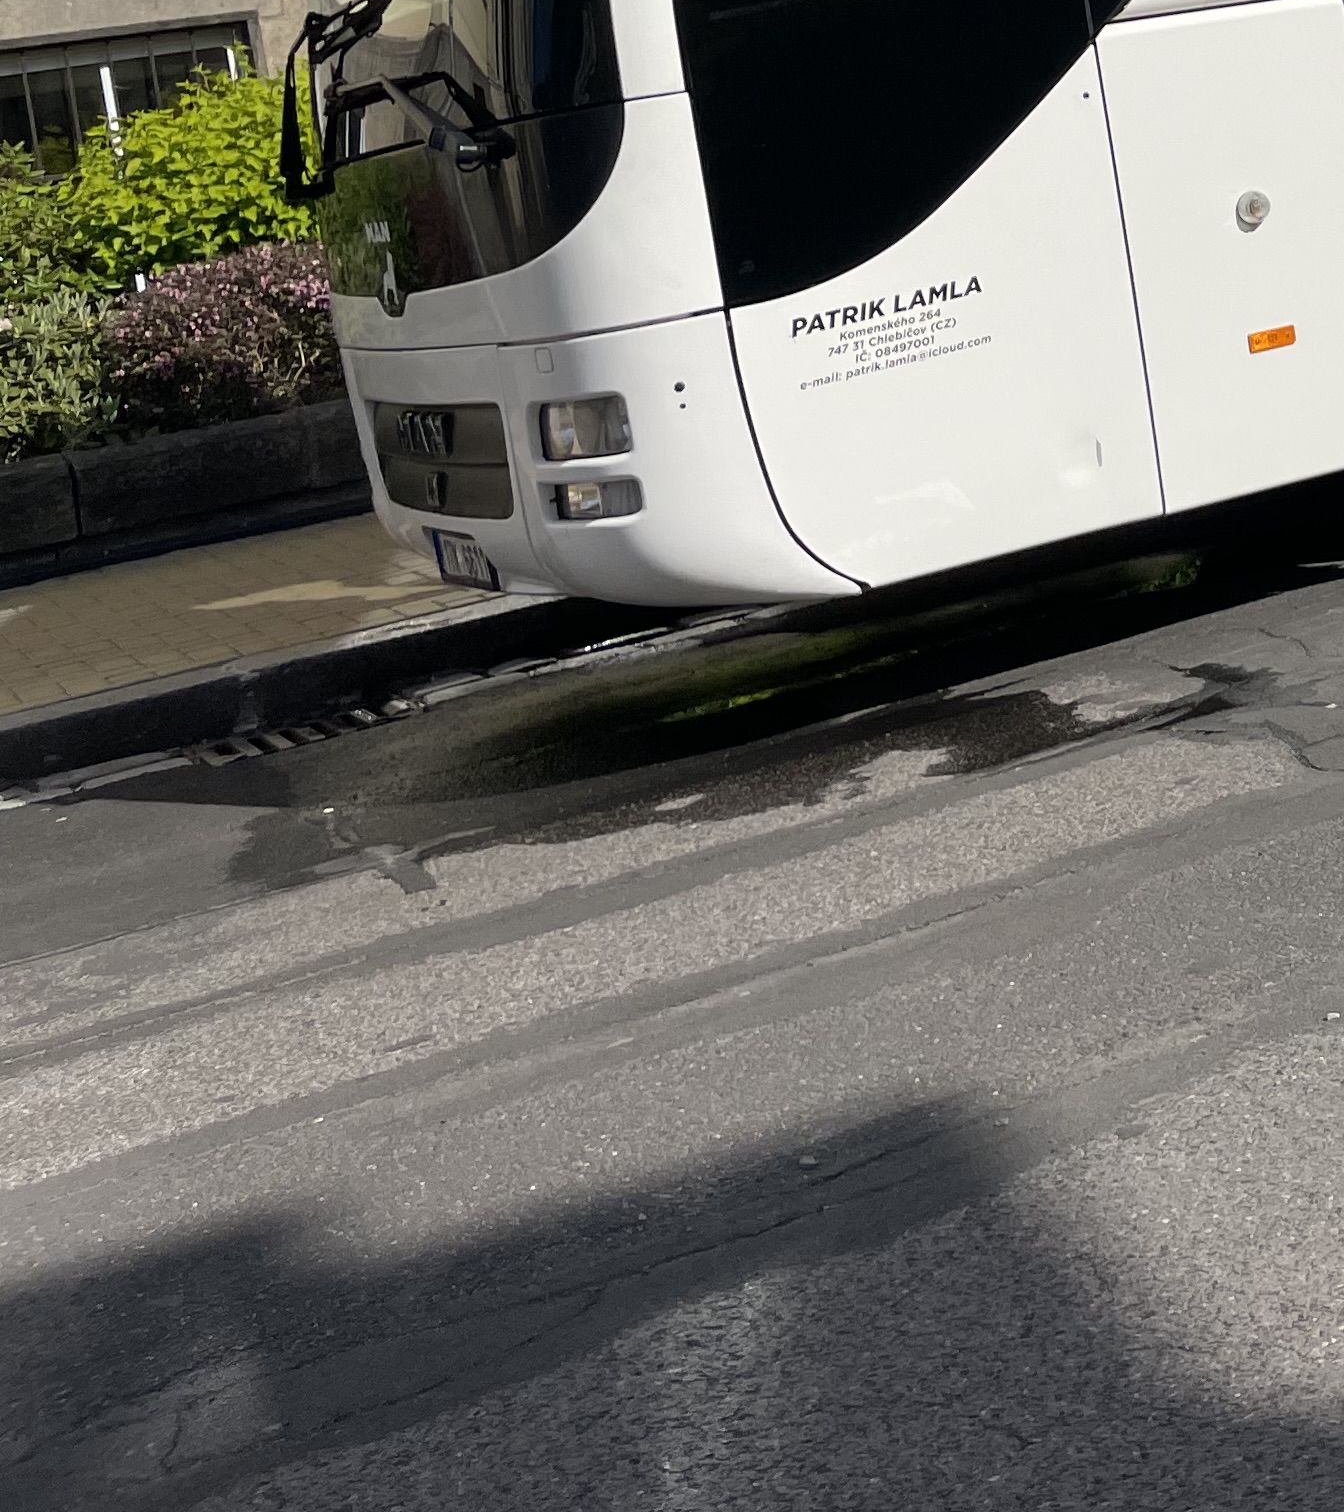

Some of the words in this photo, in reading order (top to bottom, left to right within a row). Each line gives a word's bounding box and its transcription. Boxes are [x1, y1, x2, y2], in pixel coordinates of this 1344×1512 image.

[791, 297, 886, 338] PATRIK
[893, 275, 982, 313] LAMLA
[839, 316, 916, 341] Komenského
[918, 308, 941, 323] 264
[828, 343, 849, 357] 747
[853, 340, 865, 352] 31
[930, 317, 957, 333] (CZ)
[855, 350, 872, 364] IČ:
[875, 335, 935, 358] 08497001
[800, 372, 842, 390] e-mail:
[845, 335, 992, 381] patrik.lamla@icloud.com
